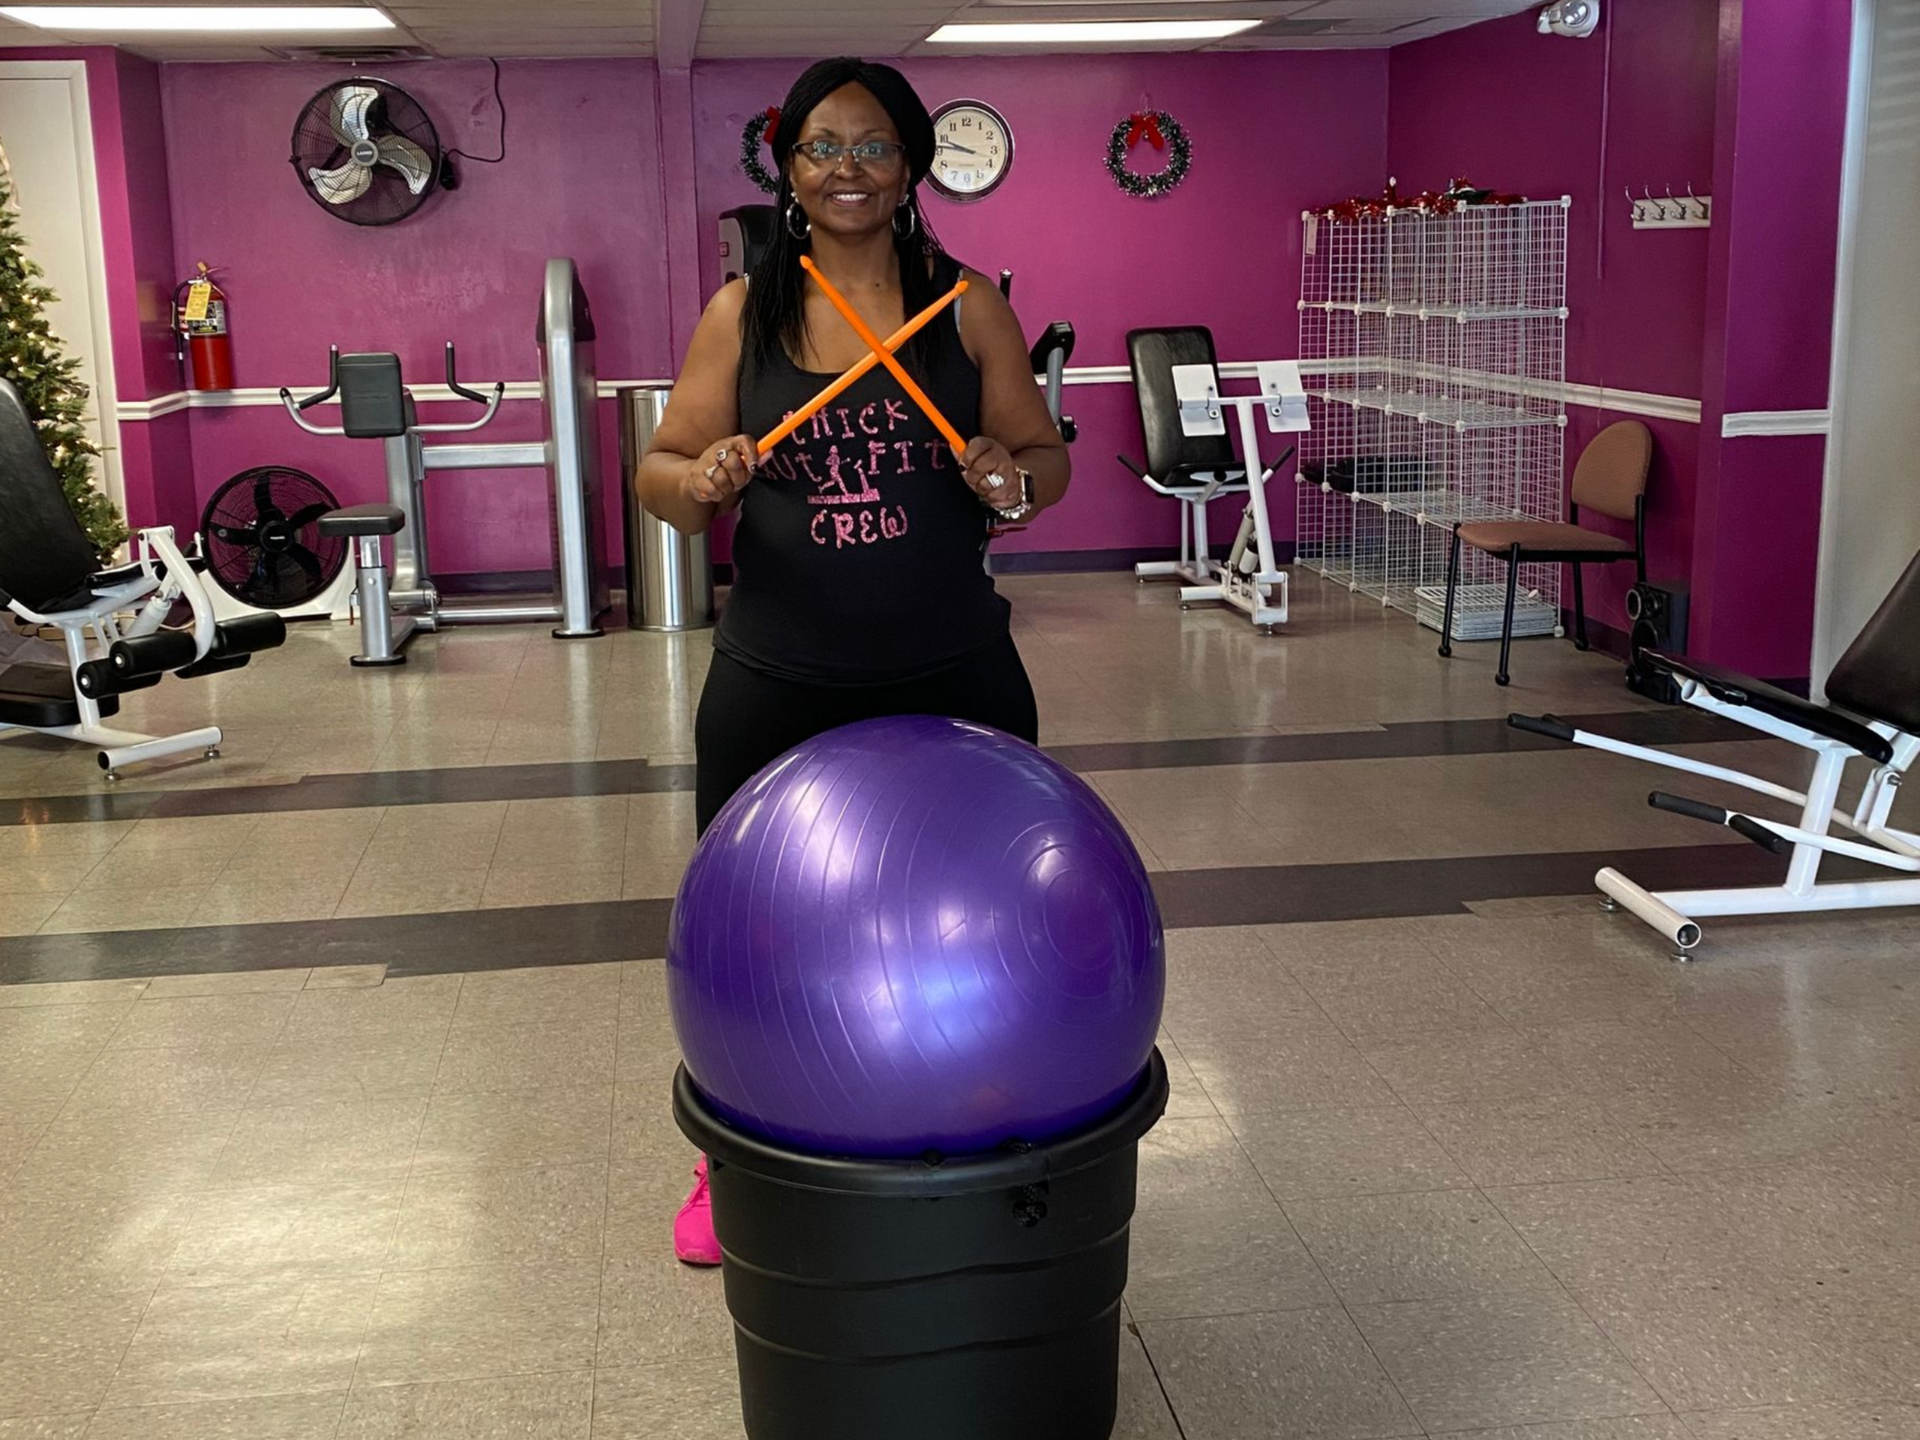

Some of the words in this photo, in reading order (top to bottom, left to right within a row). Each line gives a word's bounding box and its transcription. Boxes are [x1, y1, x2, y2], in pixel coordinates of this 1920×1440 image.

[949, 122, 957, 132] 11
[961, 117, 972, 127] 12
[978, 121, 983, 131] 1
[940, 134, 949, 143] 10
[986, 131, 994, 140] 2
[936, 147, 943, 156] 9
[990, 145, 998, 155] 3
[940, 160, 948, 170] 8
[985, 158, 993, 169] 4
[951, 171, 958, 180] 7
[963, 173, 971, 183] 6
[976, 169, 985, 179] 5
[810, 505, 908, 550] CREW
